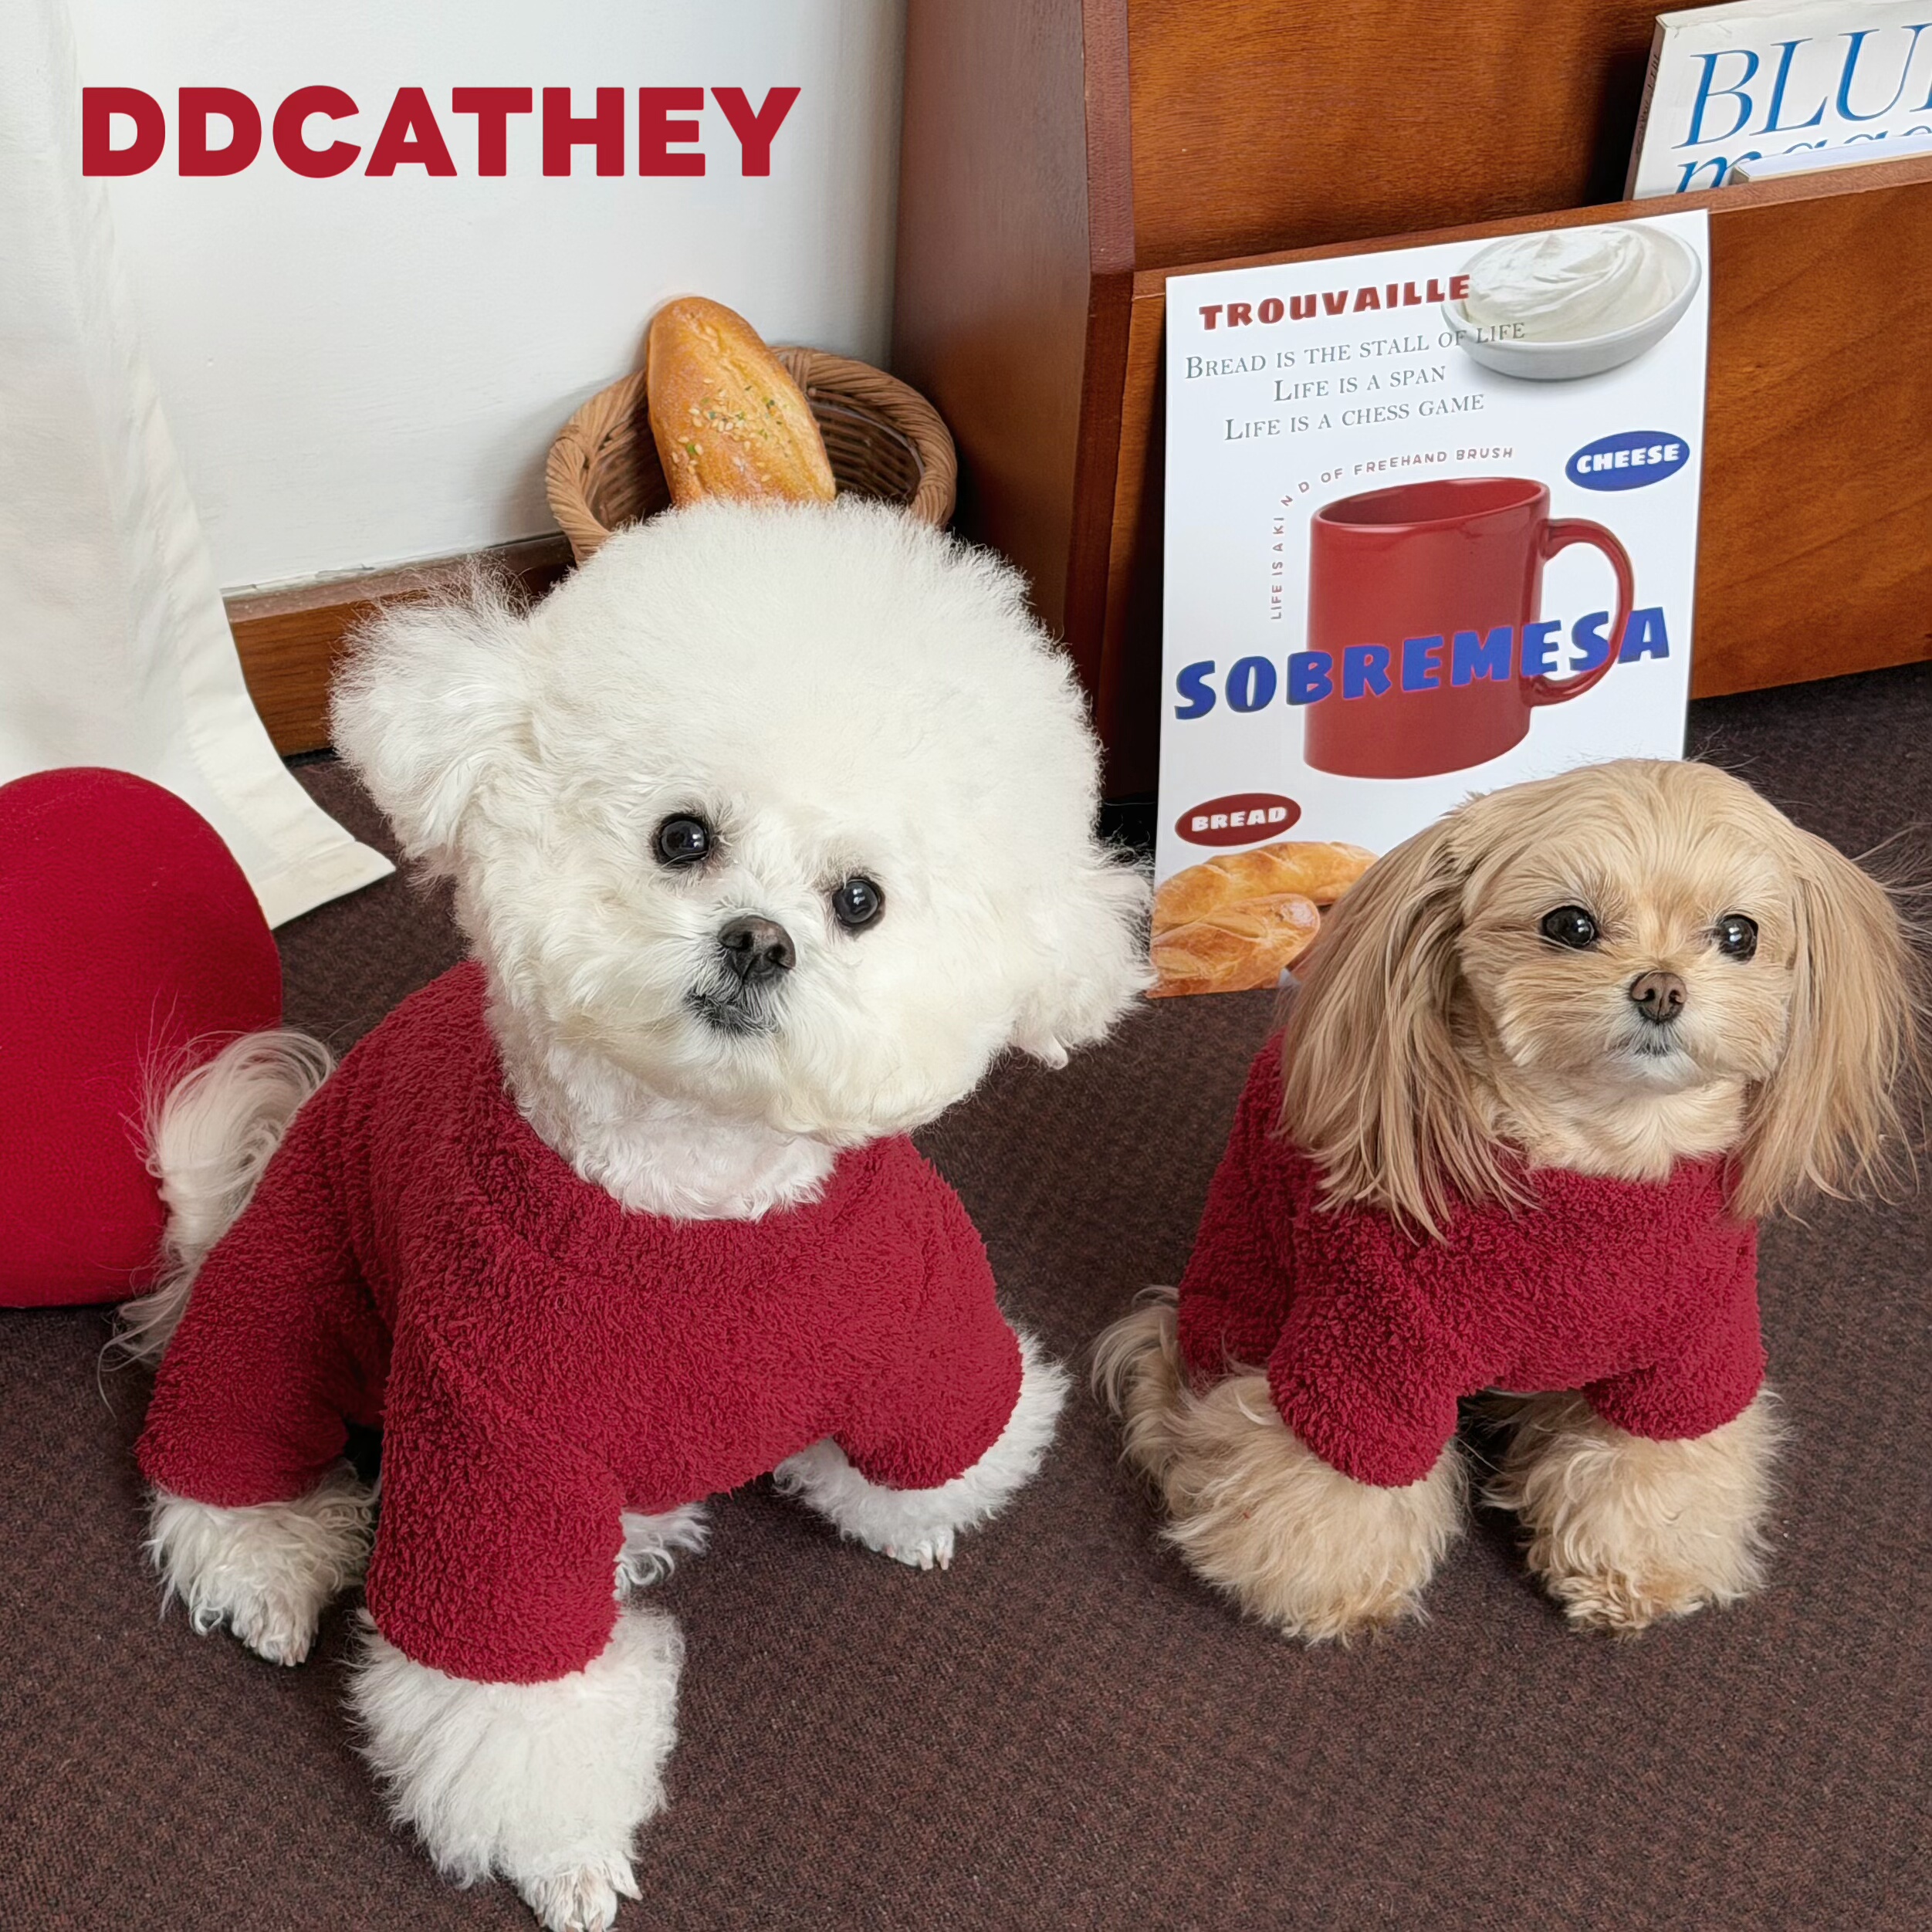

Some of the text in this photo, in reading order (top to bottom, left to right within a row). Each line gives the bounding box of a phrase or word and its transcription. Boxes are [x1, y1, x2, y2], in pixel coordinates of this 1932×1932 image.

[1670, 22, 1932, 150] BLU
[1198, 273, 1471, 330] TROUVAILLE
[1366, 374, 1380, 391] A
[1318, 414, 1331, 429] A
[1354, 451, 1447, 475] FREEHAND
[1456, 447, 1514, 461] BRUSH
[1575, 442, 1680, 474] CHEESE
[1321, 468, 1343, 483] OF
[1272, 543, 1284, 552] A
[1271, 561, 1284, 576] IS
[1271, 584, 1283, 620] LIFE
[1174, 606, 1670, 720] SOBREMESA
[1191, 806, 1287, 833] BREAD
